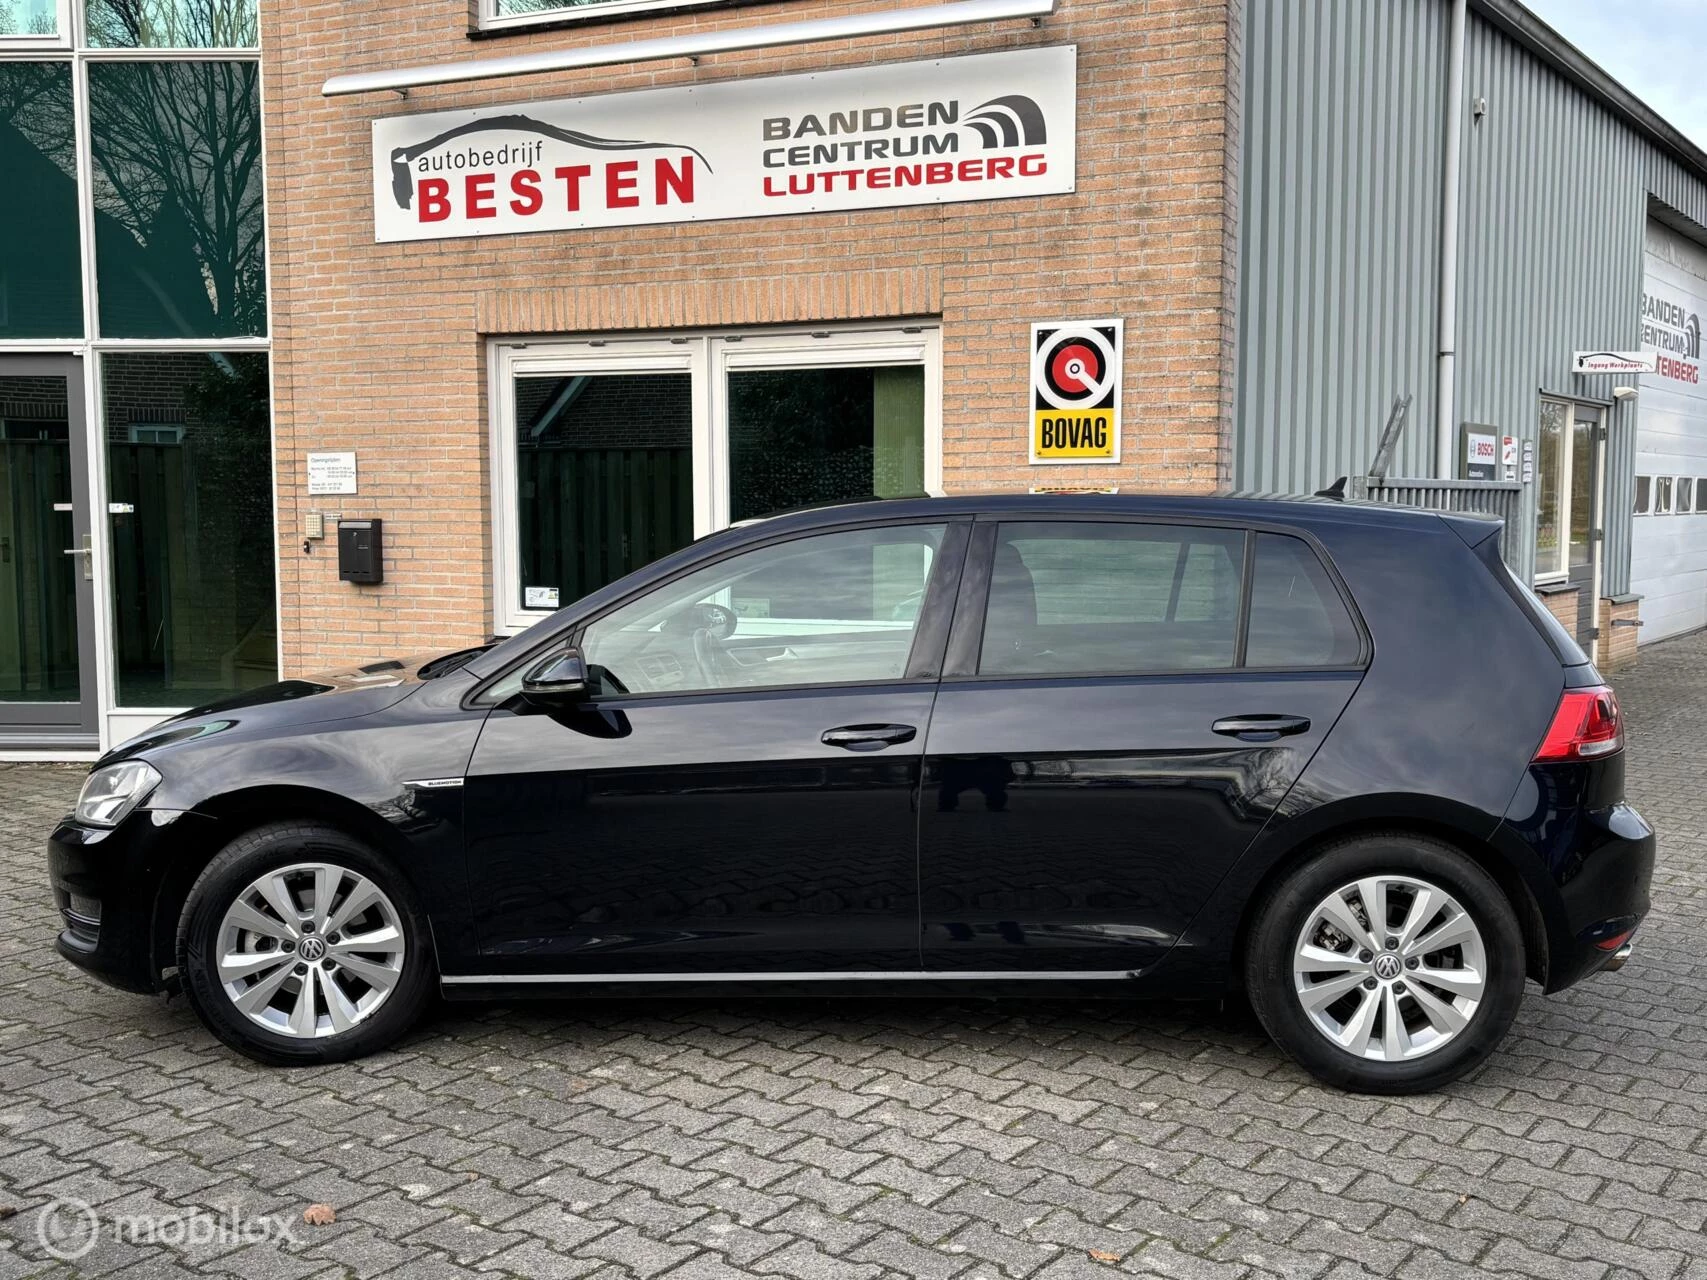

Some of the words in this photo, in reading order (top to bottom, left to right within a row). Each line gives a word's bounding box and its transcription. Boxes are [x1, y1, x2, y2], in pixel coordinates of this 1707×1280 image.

[763, 100, 959, 142] BANDEN
[417, 140, 543, 172] autobedrijf
[763, 132, 959, 169] CENTRUM
[417, 156, 695, 223] BESTEN
[763, 154, 1047, 197] LUTTENBERG
[1642, 293, 1685, 329] BANDEN
[1657, 355, 1699, 385] TENBERG
[1041, 416, 1107, 449] BOVAG
[1477, 442, 1495, 457] BOSCH
